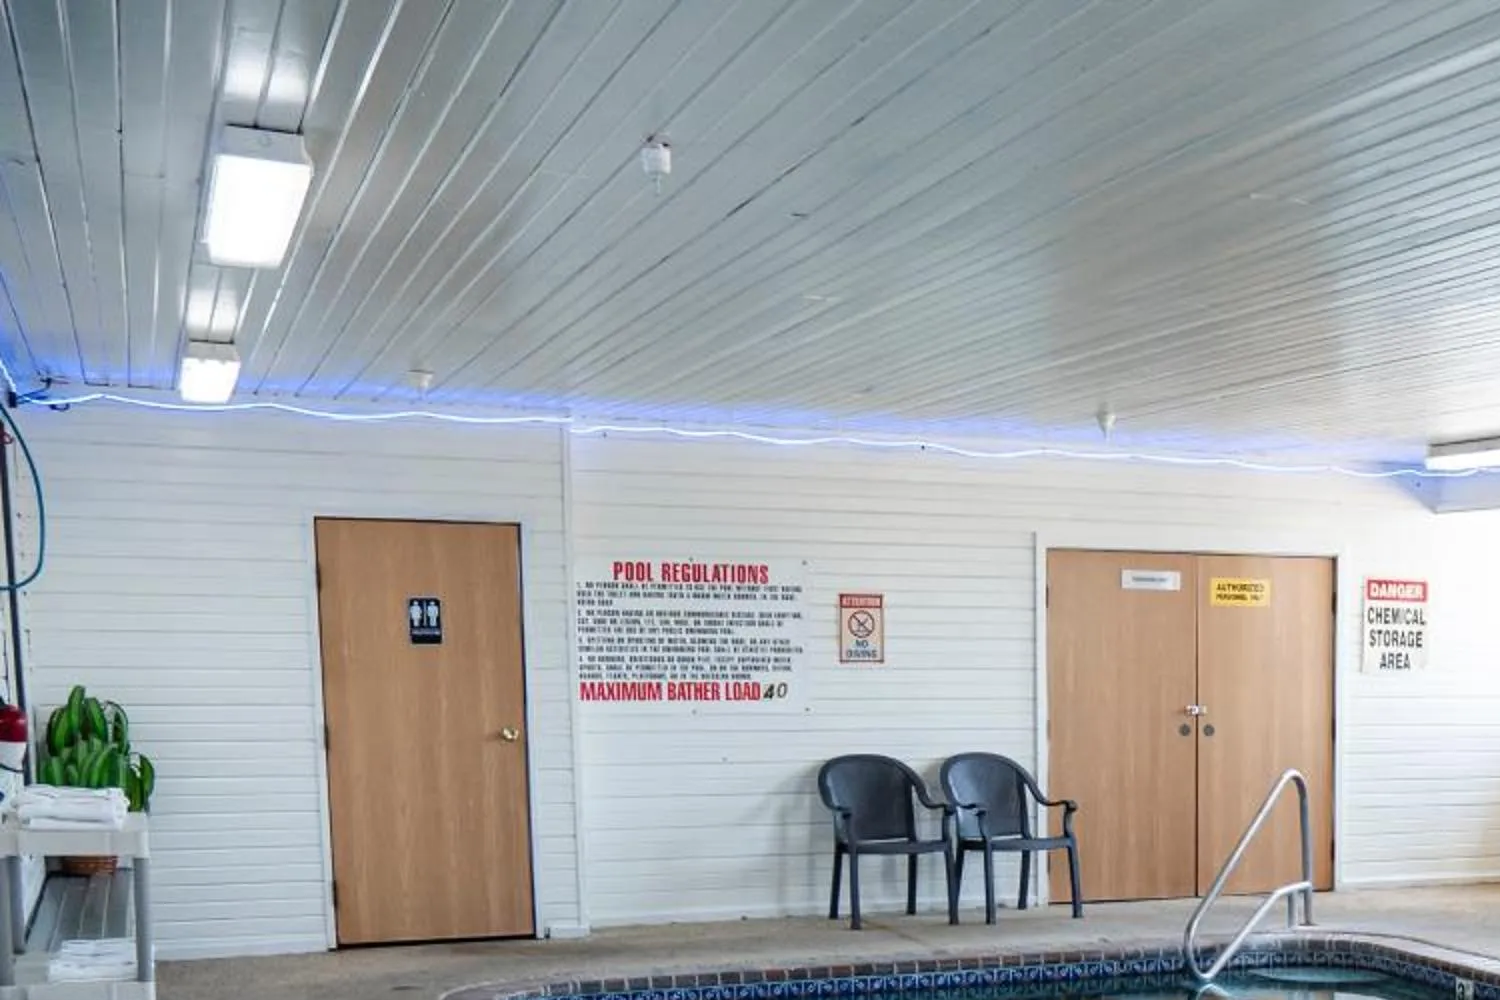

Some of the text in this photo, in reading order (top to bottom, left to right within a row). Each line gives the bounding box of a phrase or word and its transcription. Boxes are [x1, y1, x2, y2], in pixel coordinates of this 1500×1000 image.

[613, 561, 769, 584] POOL REGULATIONS
[1369, 582, 1424, 599] DANGER
[1367, 606, 1426, 625] CHEMICAL
[1369, 629, 1424, 648] STORAGE
[1379, 652, 1411, 670] AREA
[580, 682, 761, 701] MAXIMUM BATHER LOAD
[763, 682, 788, 700] 40
